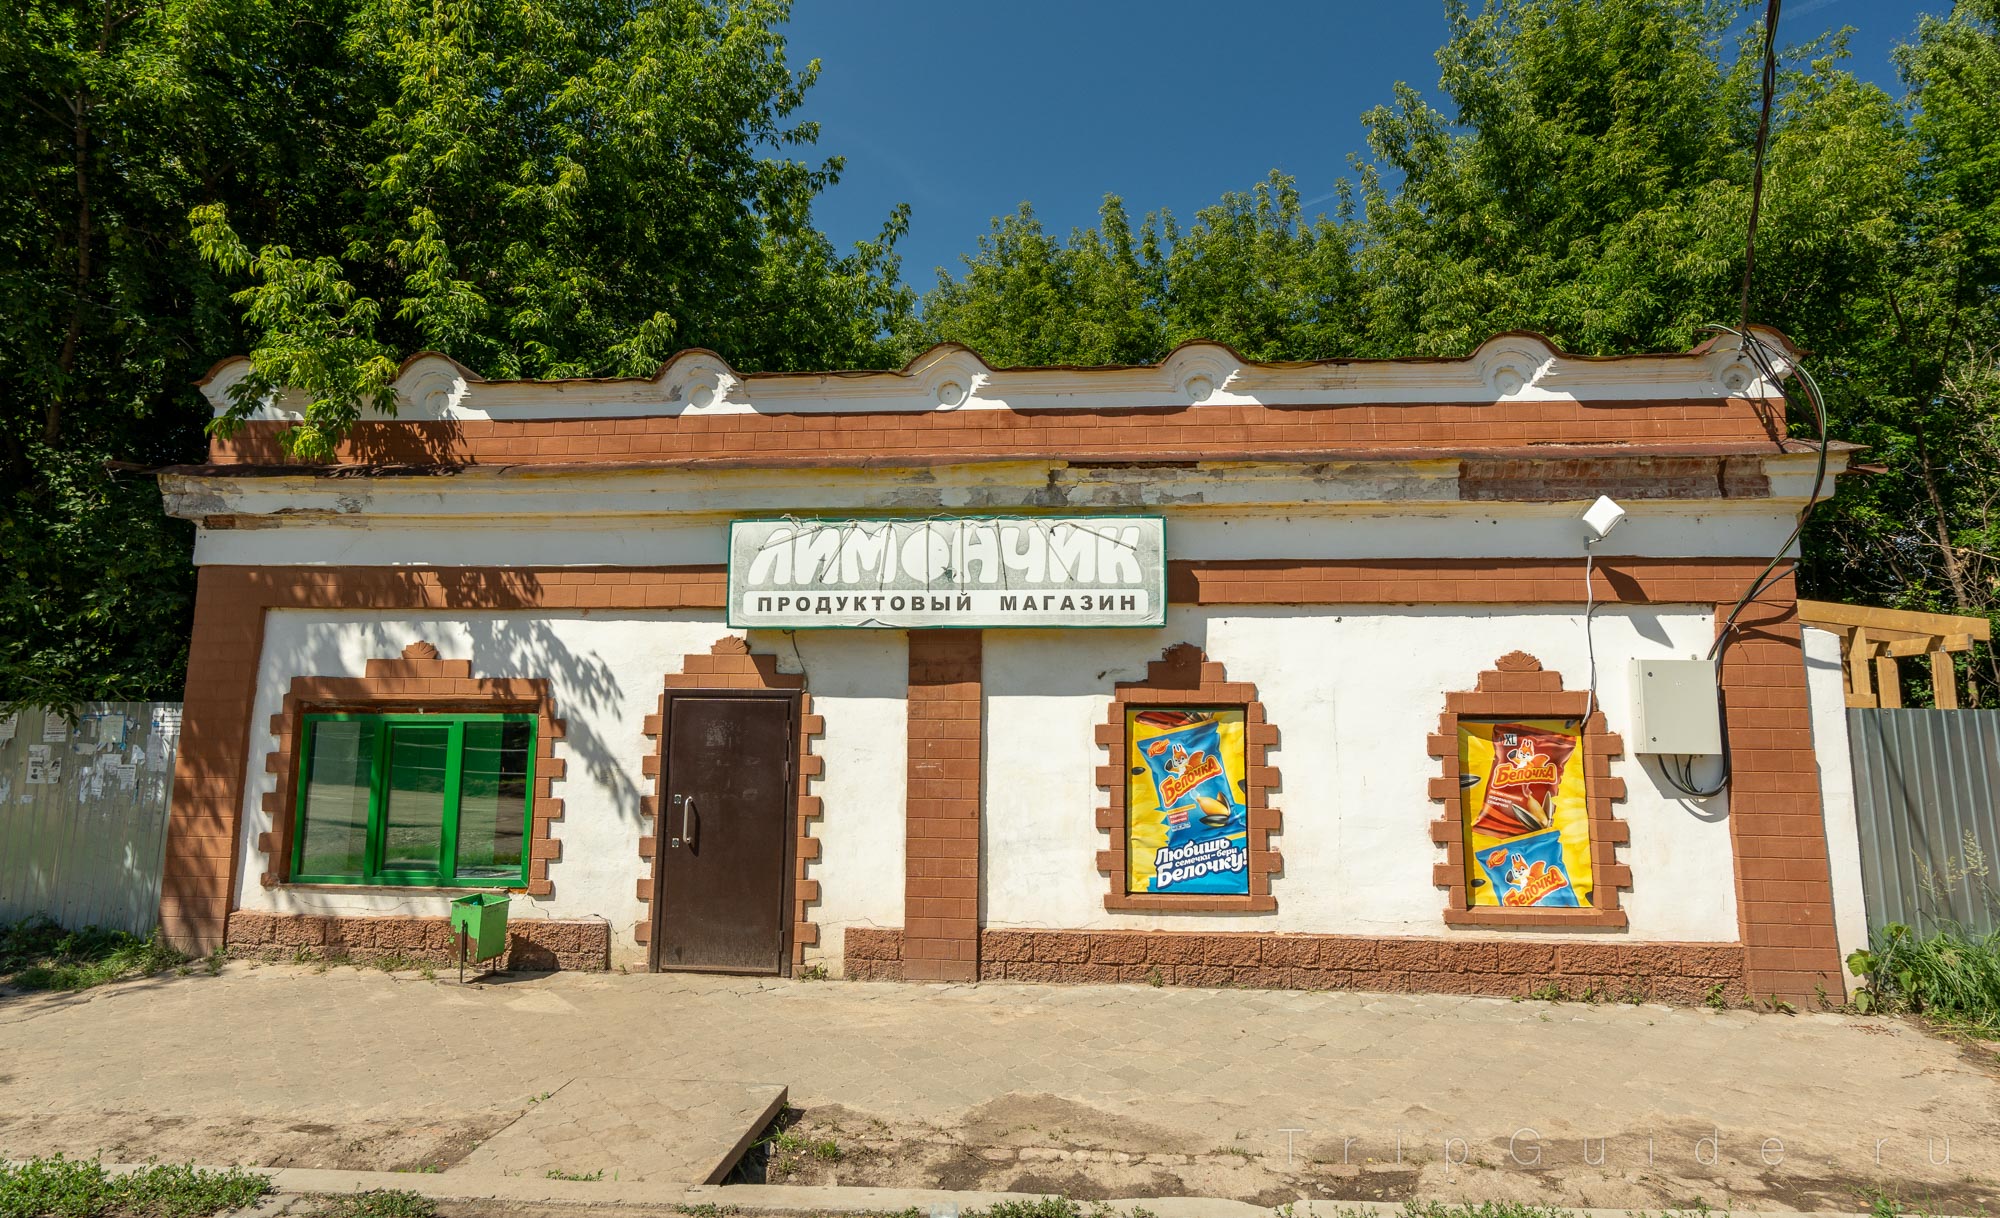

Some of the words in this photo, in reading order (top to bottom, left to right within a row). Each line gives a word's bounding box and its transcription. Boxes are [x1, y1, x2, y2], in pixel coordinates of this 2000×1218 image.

[748, 526, 1142, 583] ЛИМОНЧИК
[757, 592, 971, 614] ПРОДУКТОВЫЙ
[1000, 594, 1136, 611] МАГАЗИН
[1504, 734, 1516, 745] XL
[1155, 838, 1230, 865] Любишь
[1175, 853, 1211, 867] семечки
[1216, 848, 1238, 857] бери
[1156, 848, 1247, 888] Белочку!
